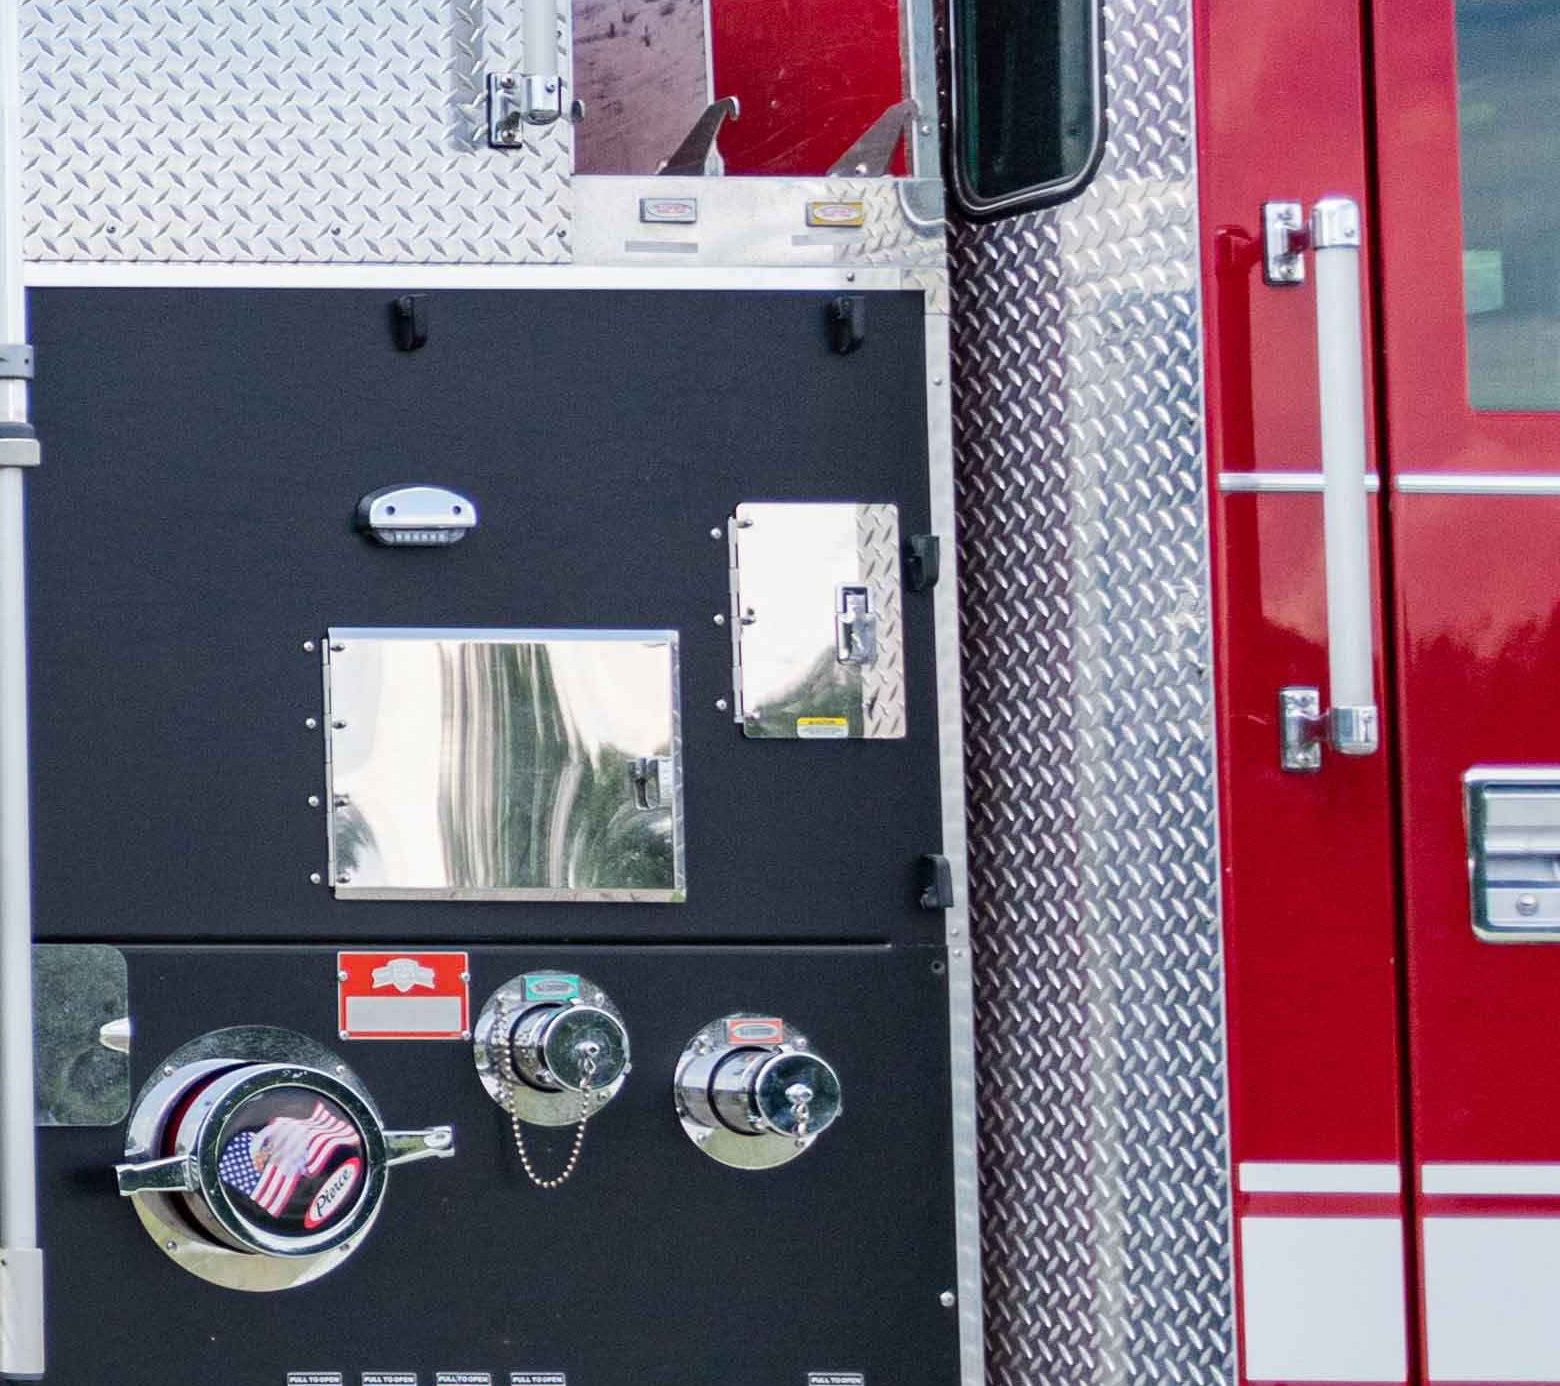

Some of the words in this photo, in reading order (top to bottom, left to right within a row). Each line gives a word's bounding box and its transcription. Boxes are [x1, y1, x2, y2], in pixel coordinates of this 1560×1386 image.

[314, 1168, 354, 1218] Pierce
[438, 1376, 457, 1384] PULL
[512, 1376, 531, 1384] PULL
